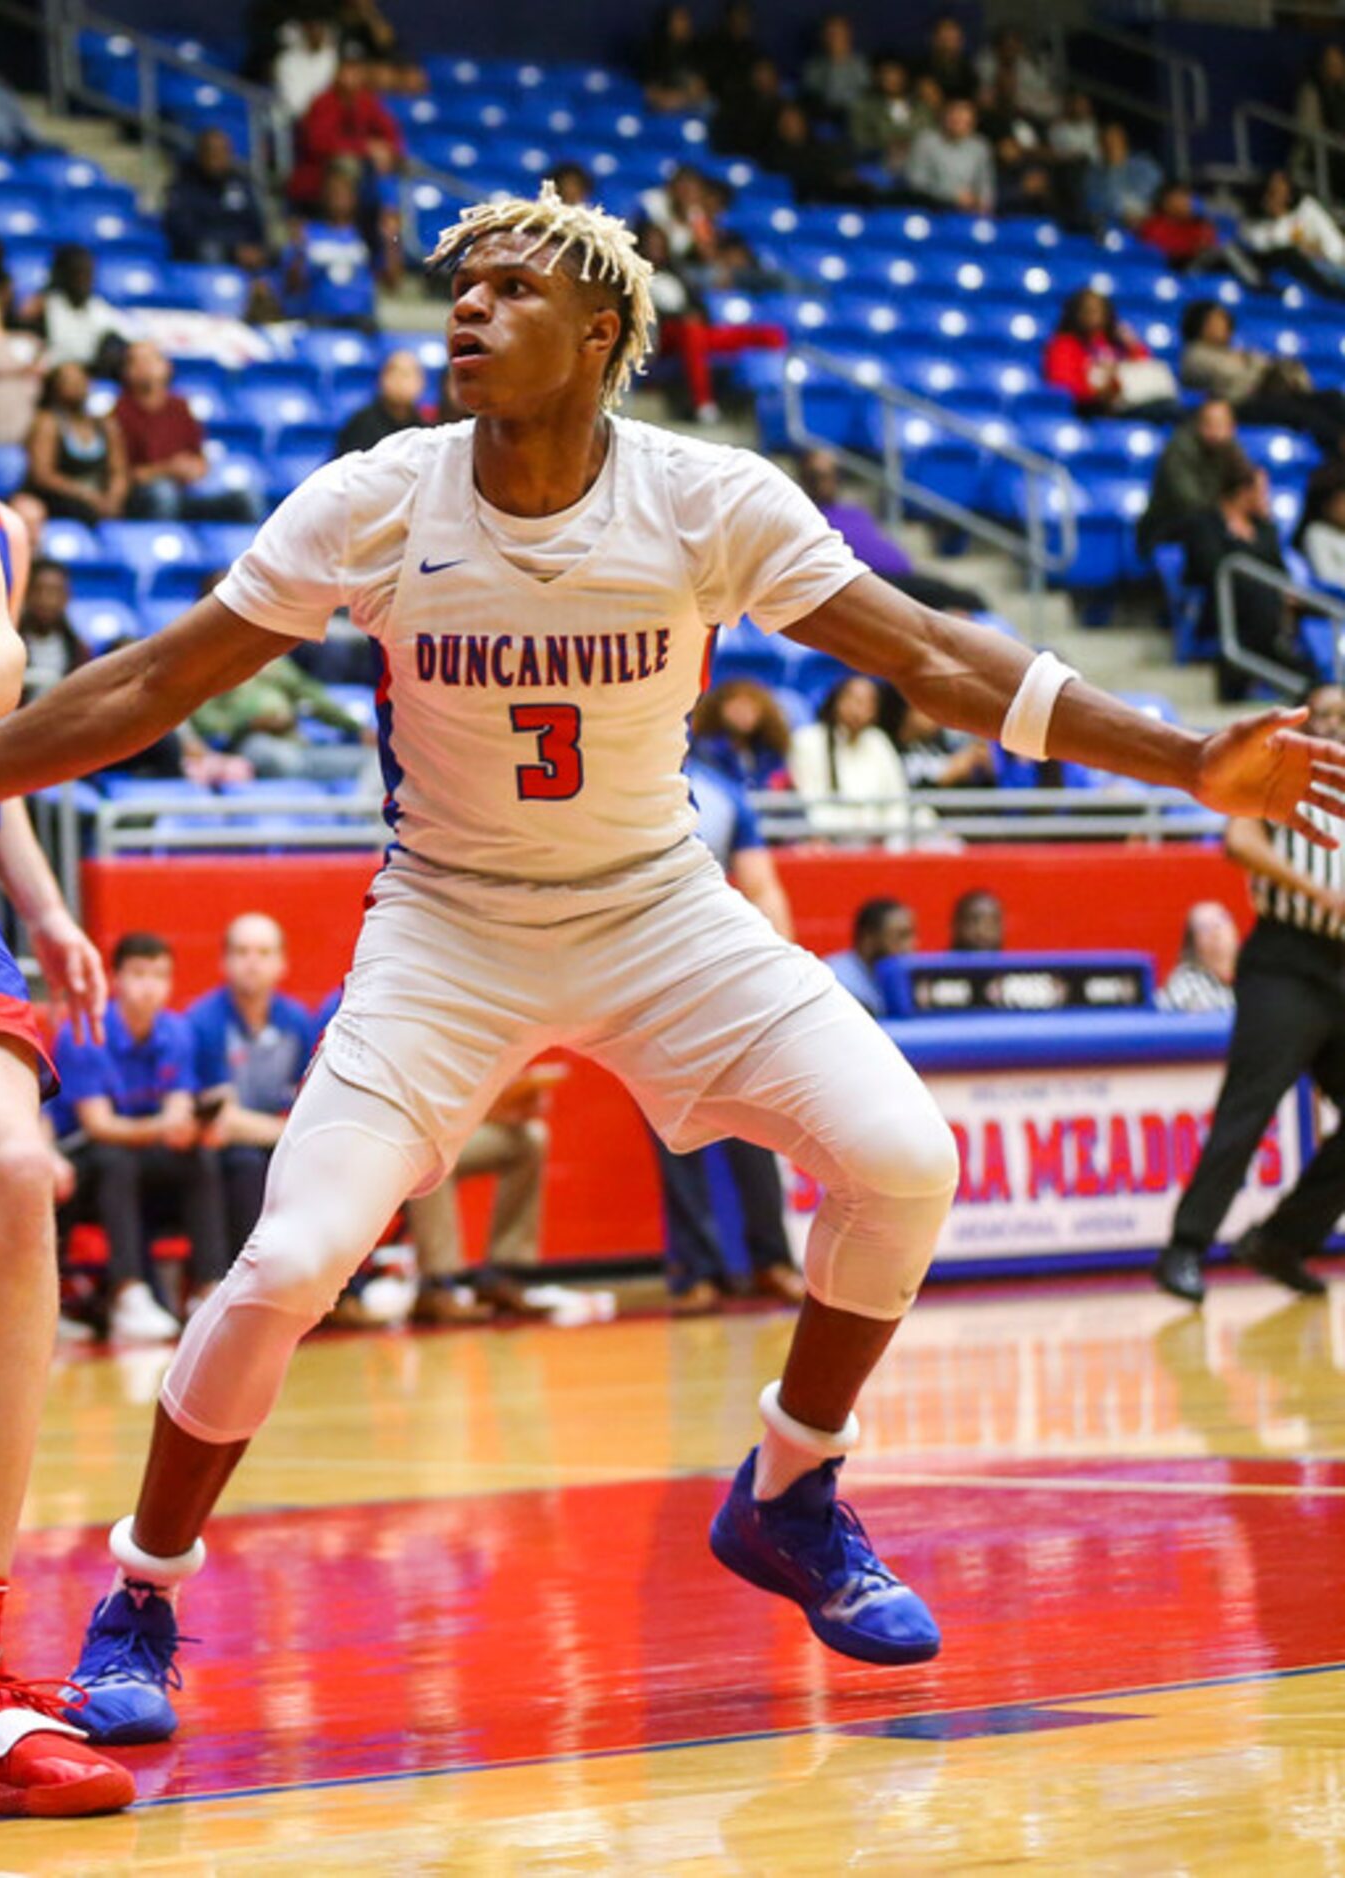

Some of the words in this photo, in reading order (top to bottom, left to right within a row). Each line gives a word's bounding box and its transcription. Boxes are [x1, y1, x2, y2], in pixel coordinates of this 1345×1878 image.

[416, 628, 670, 687] DUNCANVILLE
[509, 703, 584, 801] 3
[1023, 1110, 1283, 1202] MEADOS
